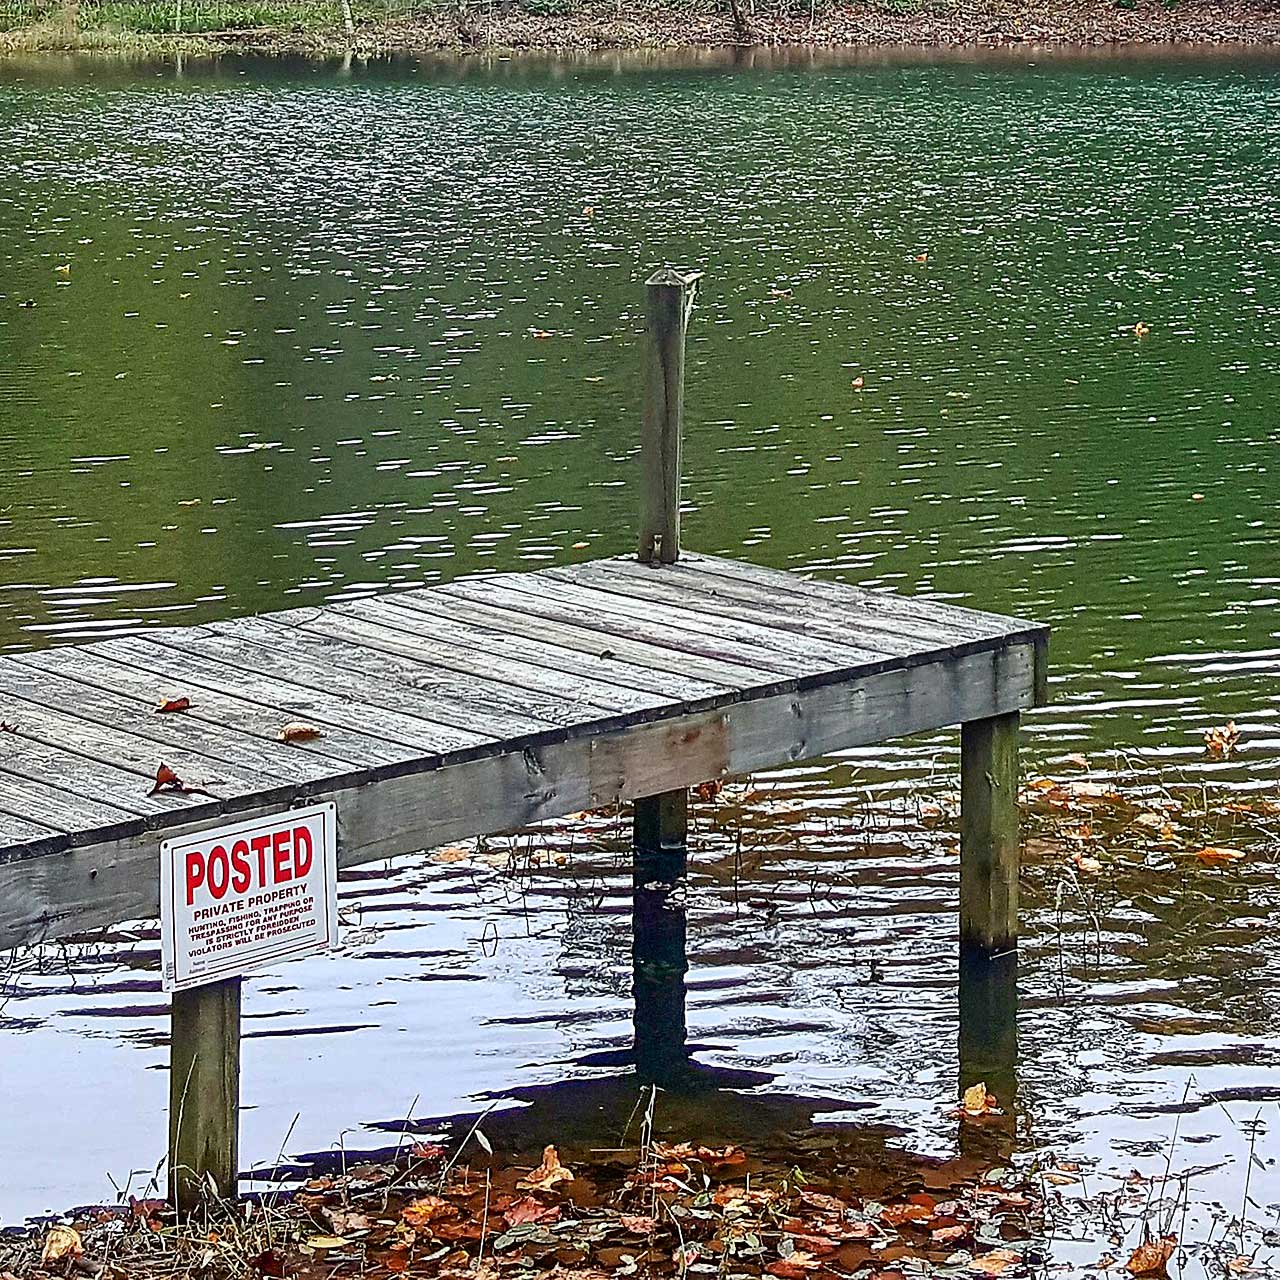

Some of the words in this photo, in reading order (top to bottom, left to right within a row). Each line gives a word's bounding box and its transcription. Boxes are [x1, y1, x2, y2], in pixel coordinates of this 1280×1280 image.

[185, 825, 313, 906] POSTED
[188, 919, 227, 935] HUNTING,
[228, 910, 262, 925] FISHING,
[263, 901, 301, 915] TRAPPING
[303, 896, 314, 905] OR
[193, 899, 245, 922] PRIVATE
[248, 883, 308, 908] PROPERTY
[188, 941, 233, 958] VIOLATORS
[235, 936, 252, 946] WILL
[254, 931, 265, 940] BE
[266, 918, 316, 938] PROSECUTED
[190, 923, 243, 942] TRESPASSING
[245, 916, 261, 928] FOR
[263, 912, 277, 925] ANY
[279, 904, 313, 919] PURPOSE
[205, 938, 214, 946] IS
[215, 928, 253, 943] STRICTLY
[256, 916, 300, 933] FORBIDDEN
